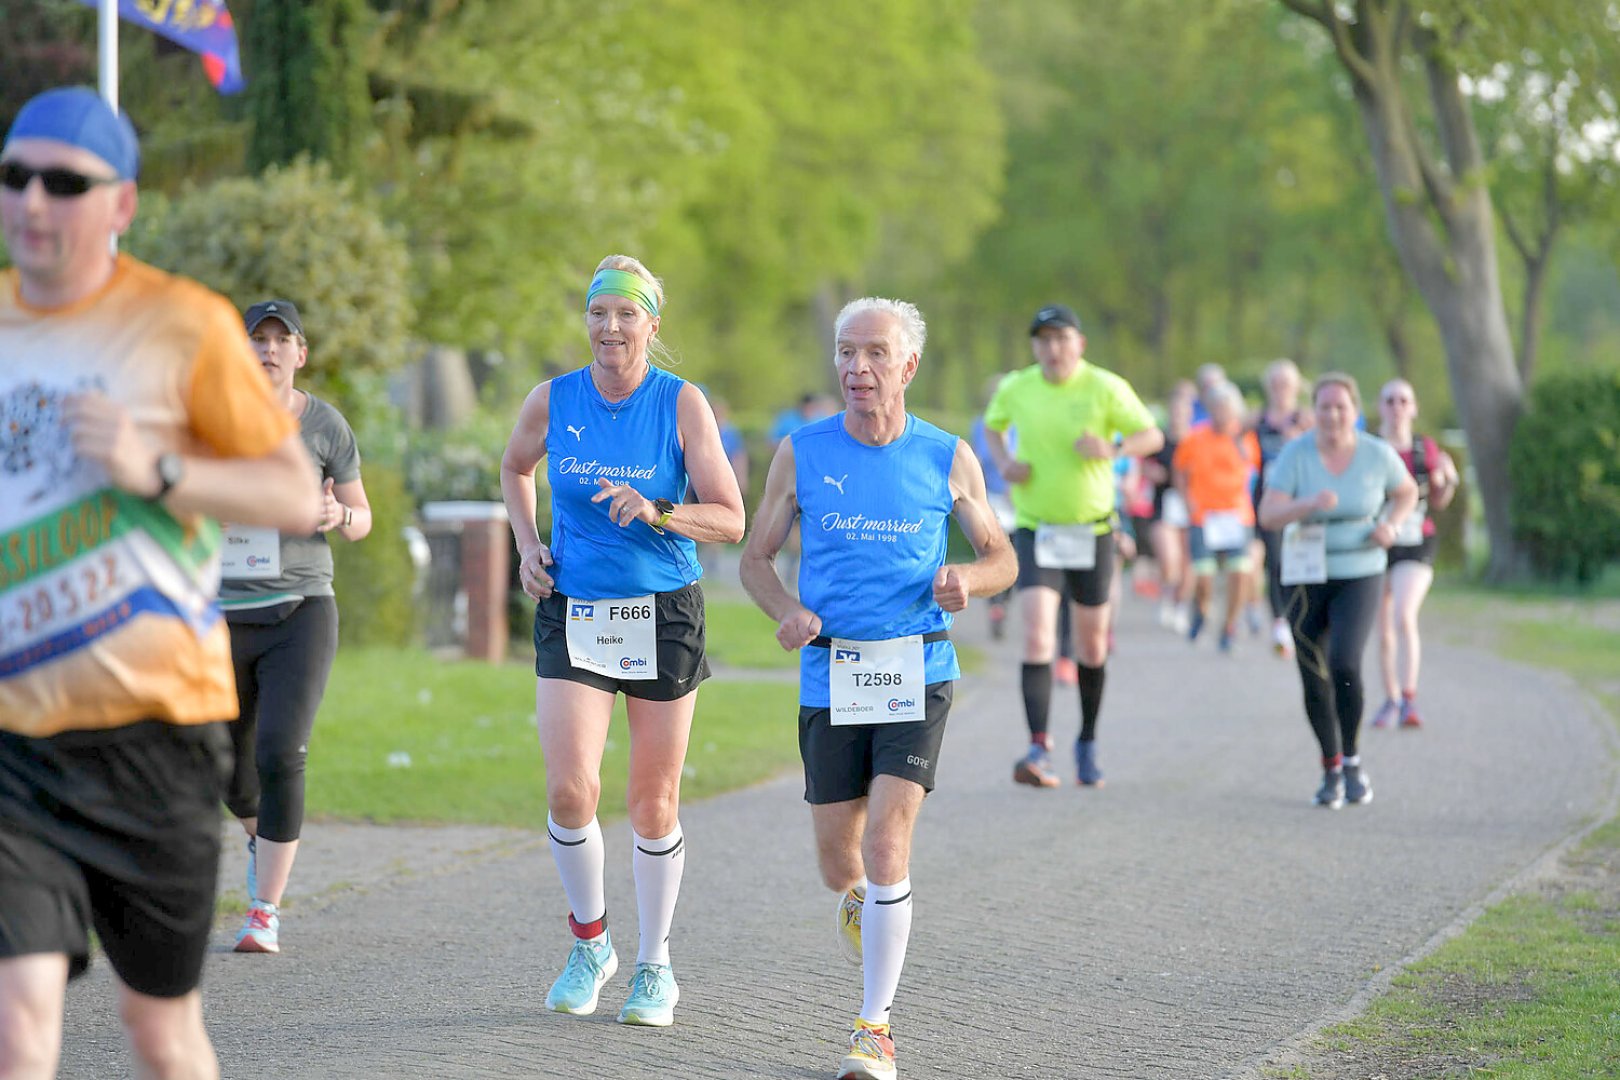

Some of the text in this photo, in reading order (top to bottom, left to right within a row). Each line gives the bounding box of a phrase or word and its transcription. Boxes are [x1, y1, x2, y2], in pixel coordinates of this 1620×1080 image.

[559, 456, 657, 480] Just married
[579, 477, 592, 485] 02.
[821, 512, 924, 534] Just married
[846, 532, 897, 543] 02. Mai 1998
[609, 605, 651, 621] F666
[596, 635, 624, 645] Heike
[620, 657, 647, 670] Combi
[852, 673, 902, 687] T2598
[835, 705, 874, 713] WILDEBOER
[888, 698, 915, 712] Combi
[907, 754, 930, 769] GORE
